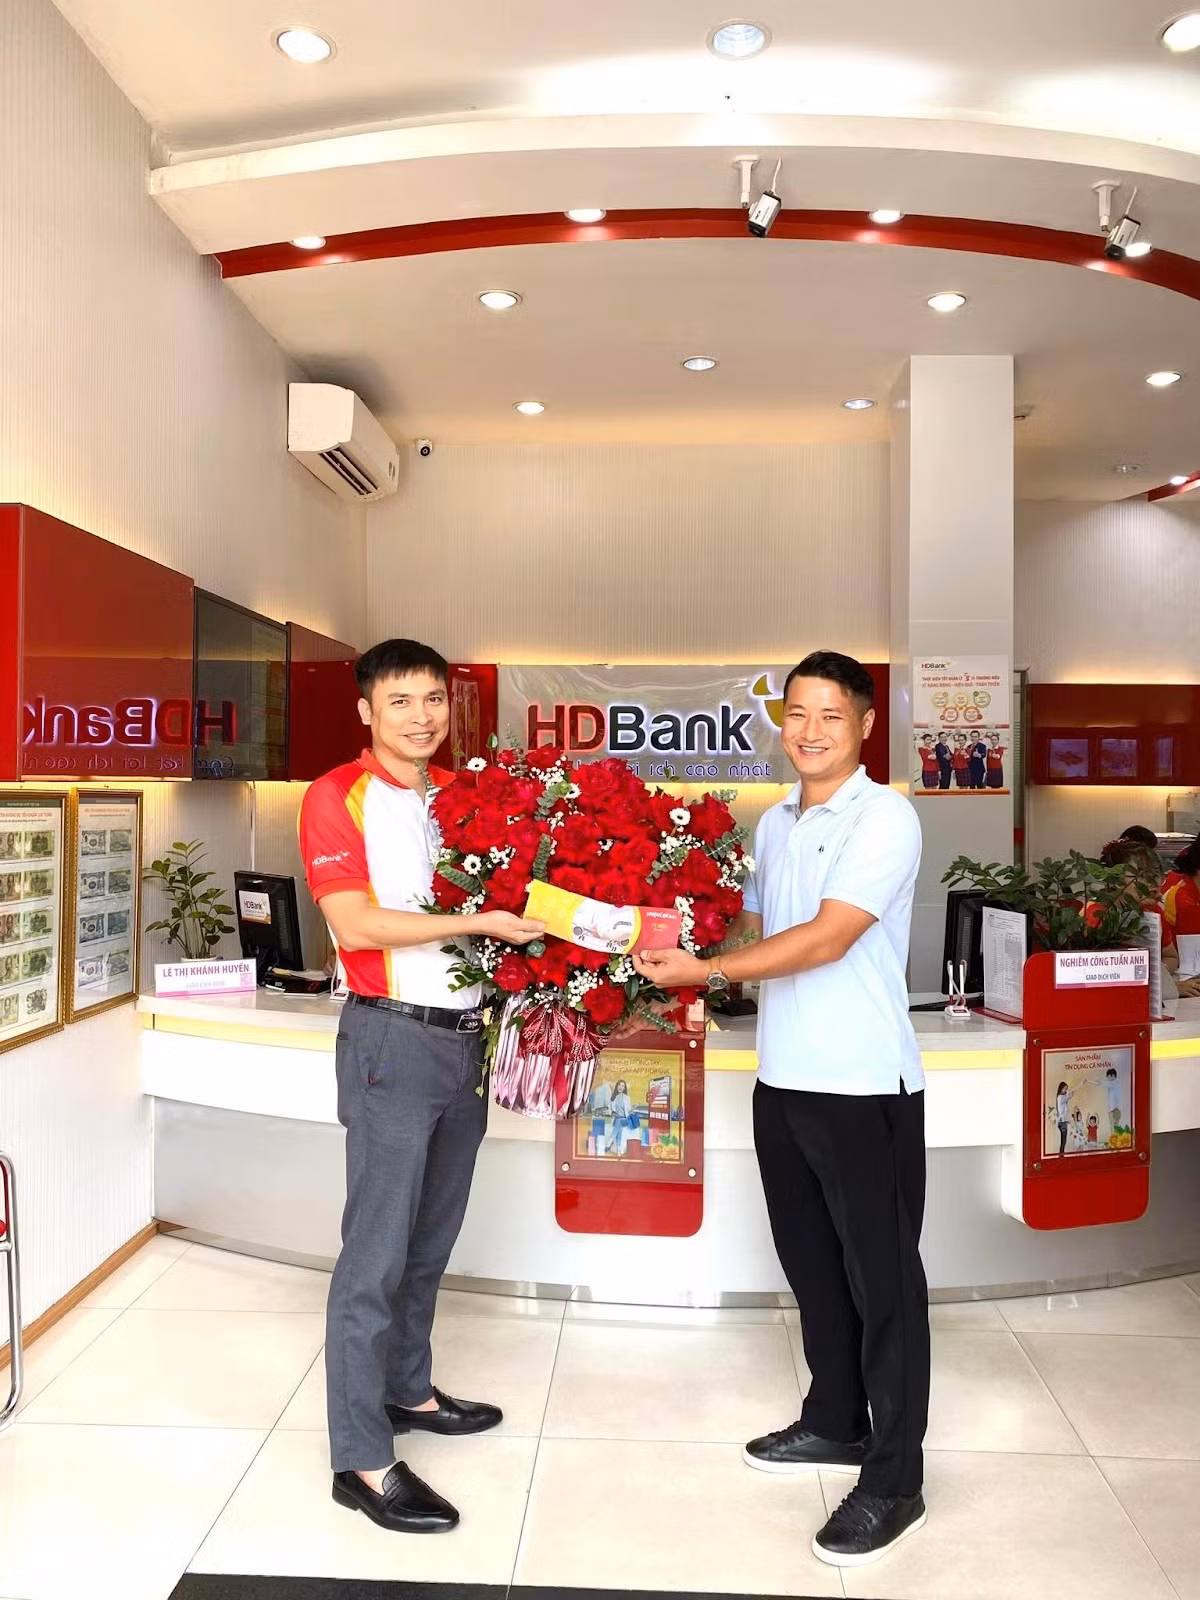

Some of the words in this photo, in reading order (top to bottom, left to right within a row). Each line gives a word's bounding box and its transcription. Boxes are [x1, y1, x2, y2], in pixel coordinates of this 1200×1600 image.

[526, 704, 753, 752] HDBank
[650, 760, 676, 777] ích
[685, 764, 718, 776] cao
[729, 760, 772, 777] nhất
[311, 853, 343, 867] HDBank
[244, 900, 263, 910] HDBank
[1060, 956, 1088, 968] NGHIÊM
[1090, 955, 1109, 966] CÔNG
[1110, 954, 1128, 966] TUẤN
[1129, 955, 1145, 965] ANH
[163, 967, 172, 977] LÊ
[174, 968, 188, 978] THỊ
[190, 965, 220, 976] KHÁNH
